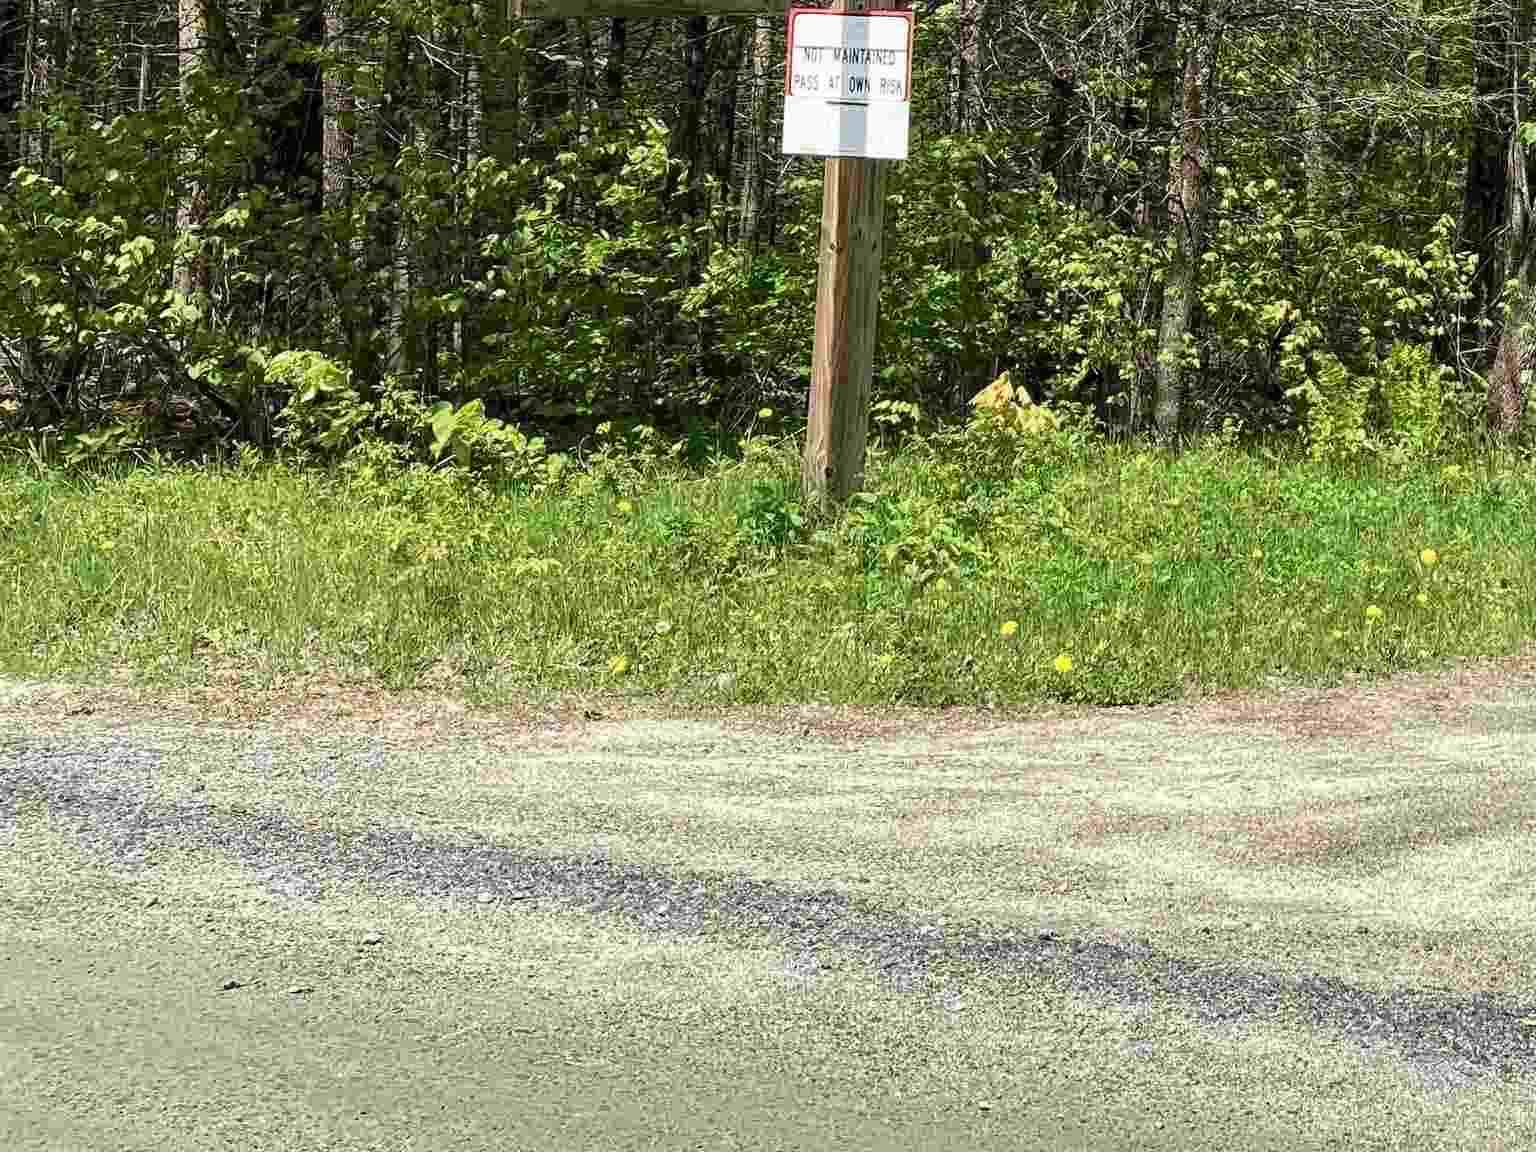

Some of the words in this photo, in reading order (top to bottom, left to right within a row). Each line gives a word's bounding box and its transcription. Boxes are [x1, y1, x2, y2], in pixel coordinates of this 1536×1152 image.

[803, 47, 824, 64] NOT
[834, 48, 897, 66] MAINTAINED
[794, 74, 819, 92] PASS
[828, 74, 841, 90] AT
[848, 75, 872, 94] OWN
[880, 77, 903, 96] RISK
